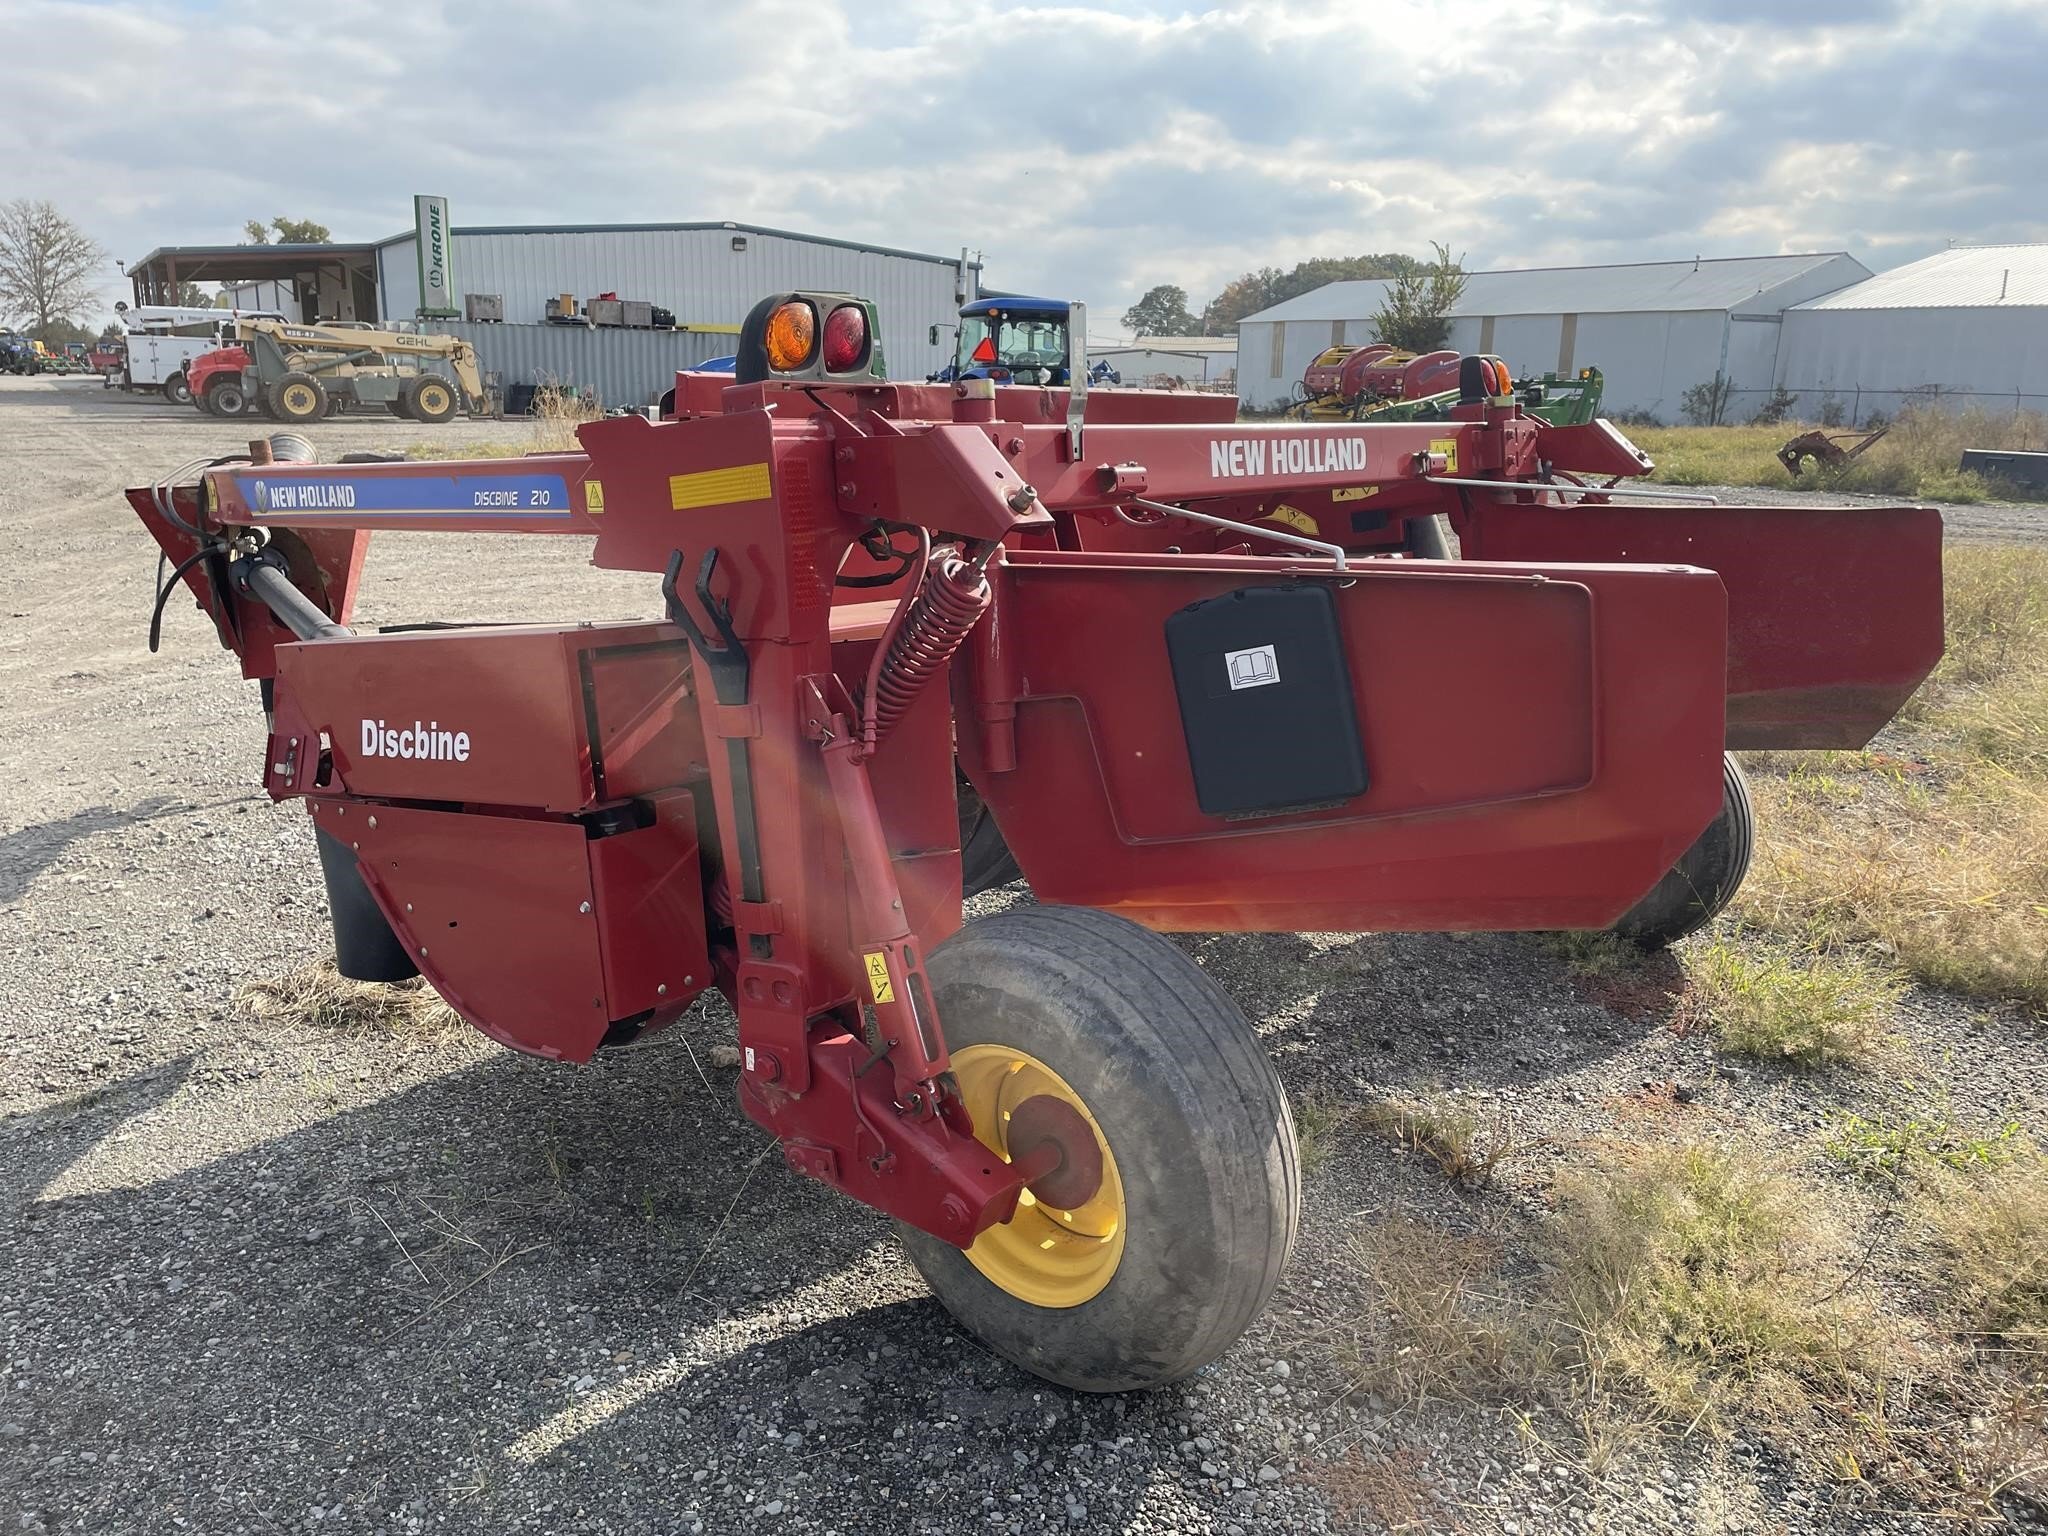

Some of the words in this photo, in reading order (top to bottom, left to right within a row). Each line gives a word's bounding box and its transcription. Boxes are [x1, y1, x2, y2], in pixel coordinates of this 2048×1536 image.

[430, 204, 442, 269] KRONE
[396, 336, 433, 347] GEHL
[1210, 440, 1266, 477] NEW
[1271, 438, 1367, 475] HOLLAND
[270, 487, 297, 508] NEW
[298, 485, 355, 507] HOLLAND
[474, 491, 518, 506] DISCBINE
[530, 490, 550, 505] 210
[361, 719, 470, 761] Discbine
